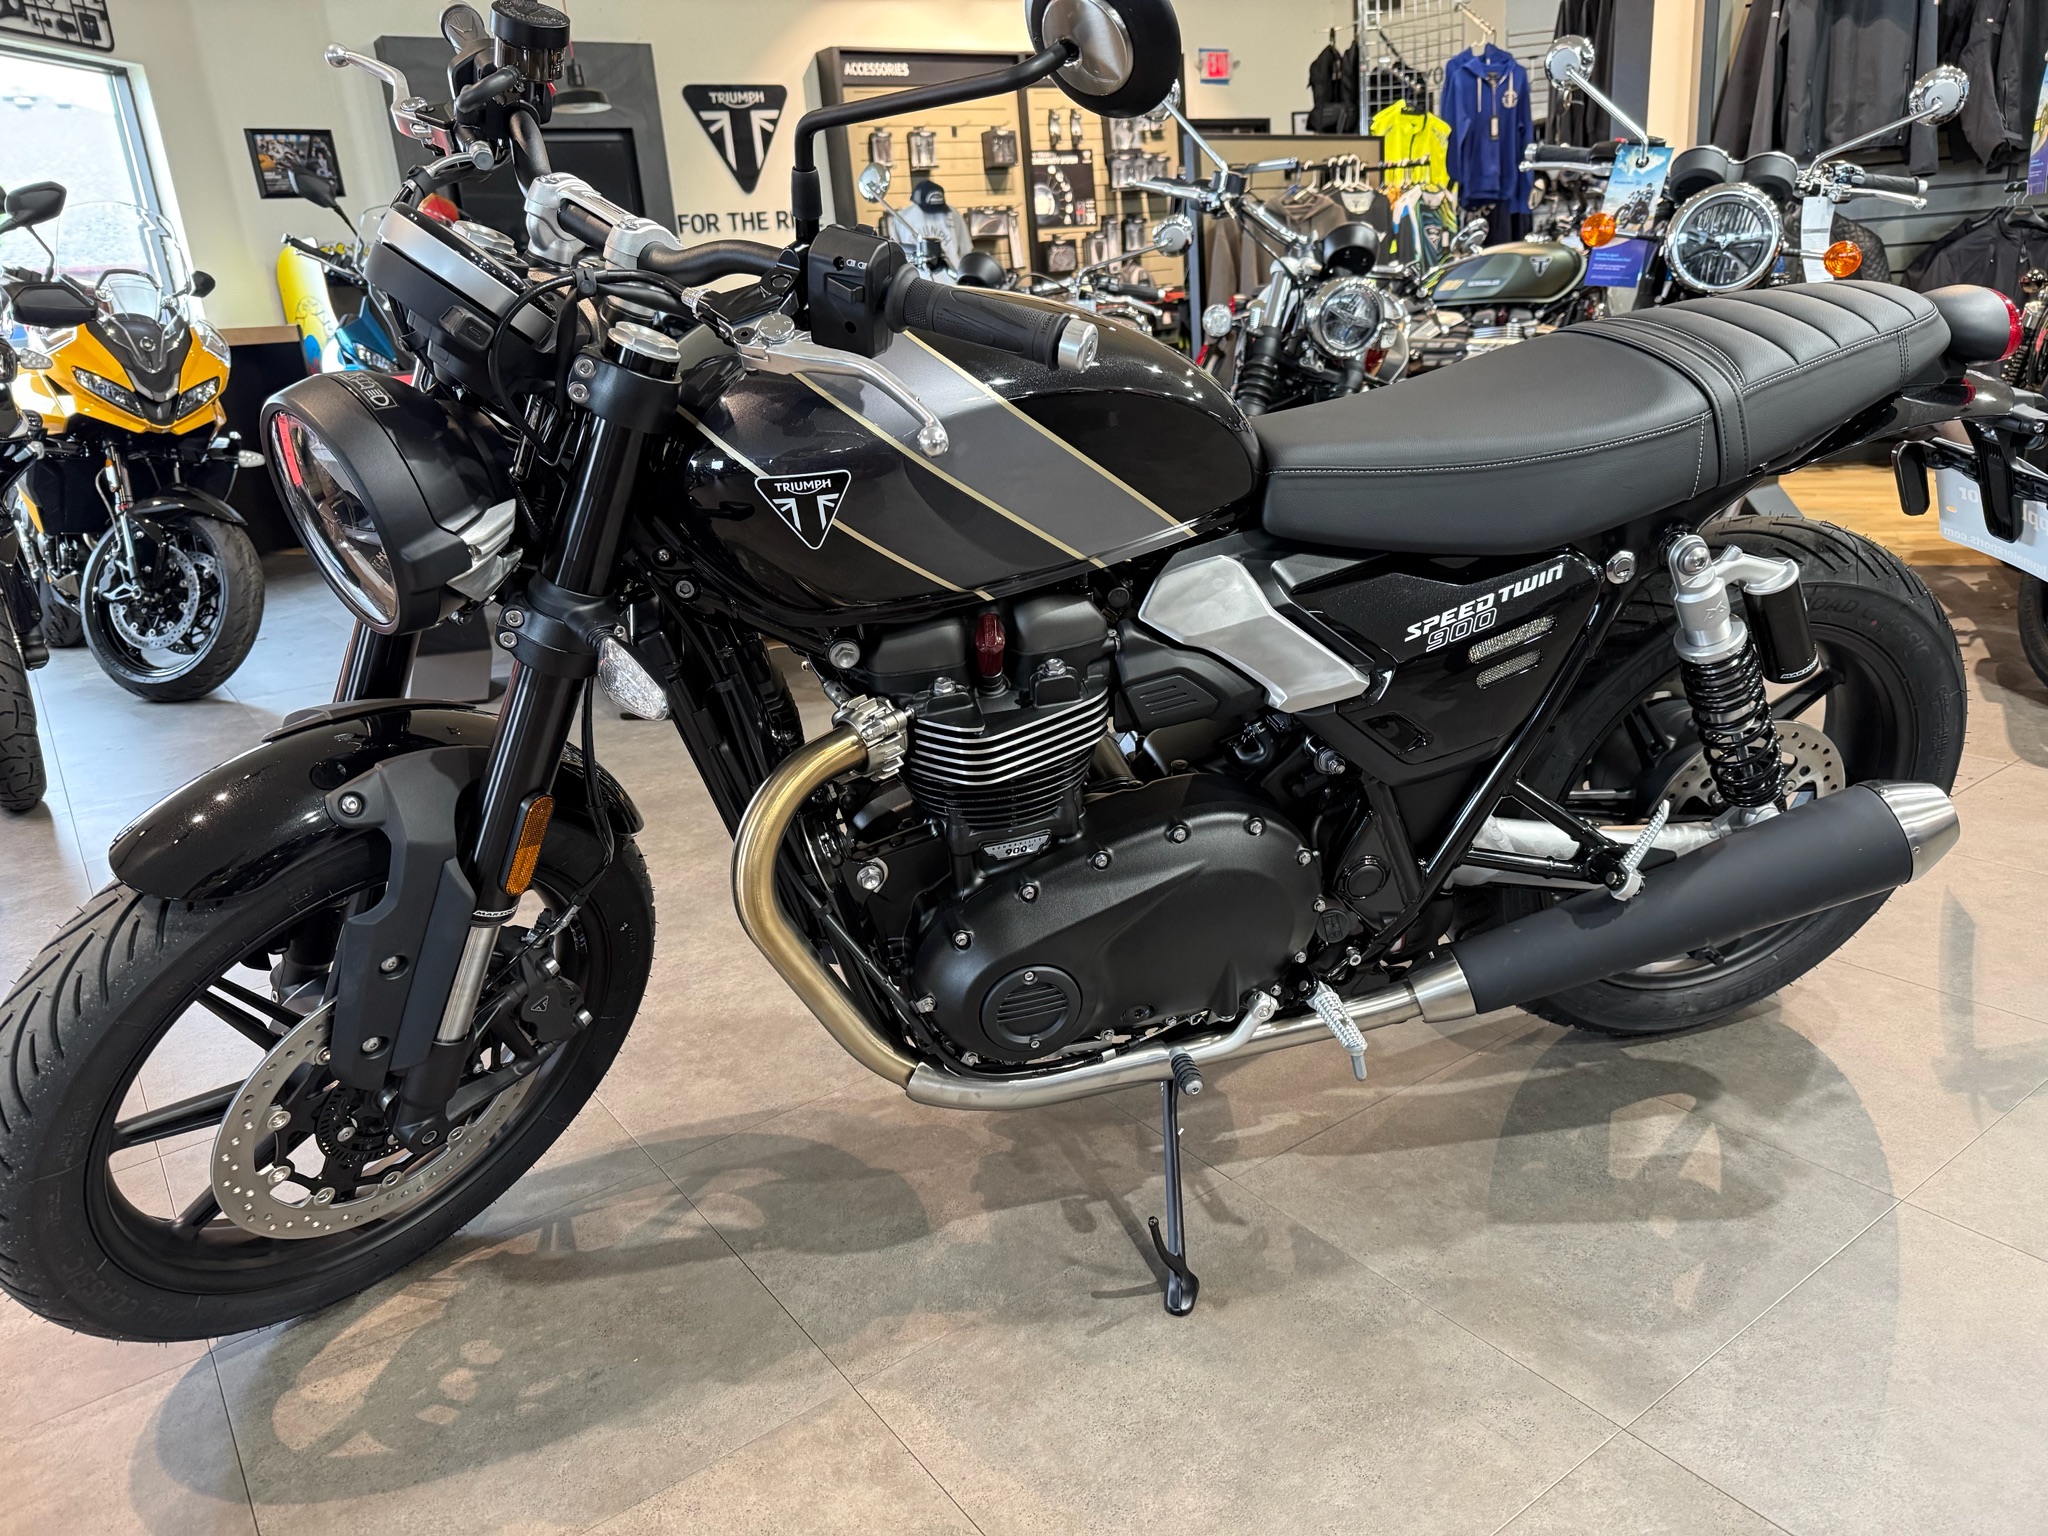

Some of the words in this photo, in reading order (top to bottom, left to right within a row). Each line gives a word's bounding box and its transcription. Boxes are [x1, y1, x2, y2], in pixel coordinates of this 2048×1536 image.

[844, 62, 909, 76] ACCESSORIES
[708, 91, 765, 105] TRIUMPH
[678, 213, 720, 234] FOR
[726, 211, 769, 233] THE
[774, 478, 832, 493] TRIUMPH
[1404, 593, 1495, 642] SPEED
[1498, 563, 1564, 602] TWIN
[1426, 607, 1497, 652] 900
[1005, 845, 1027, 855] 900
